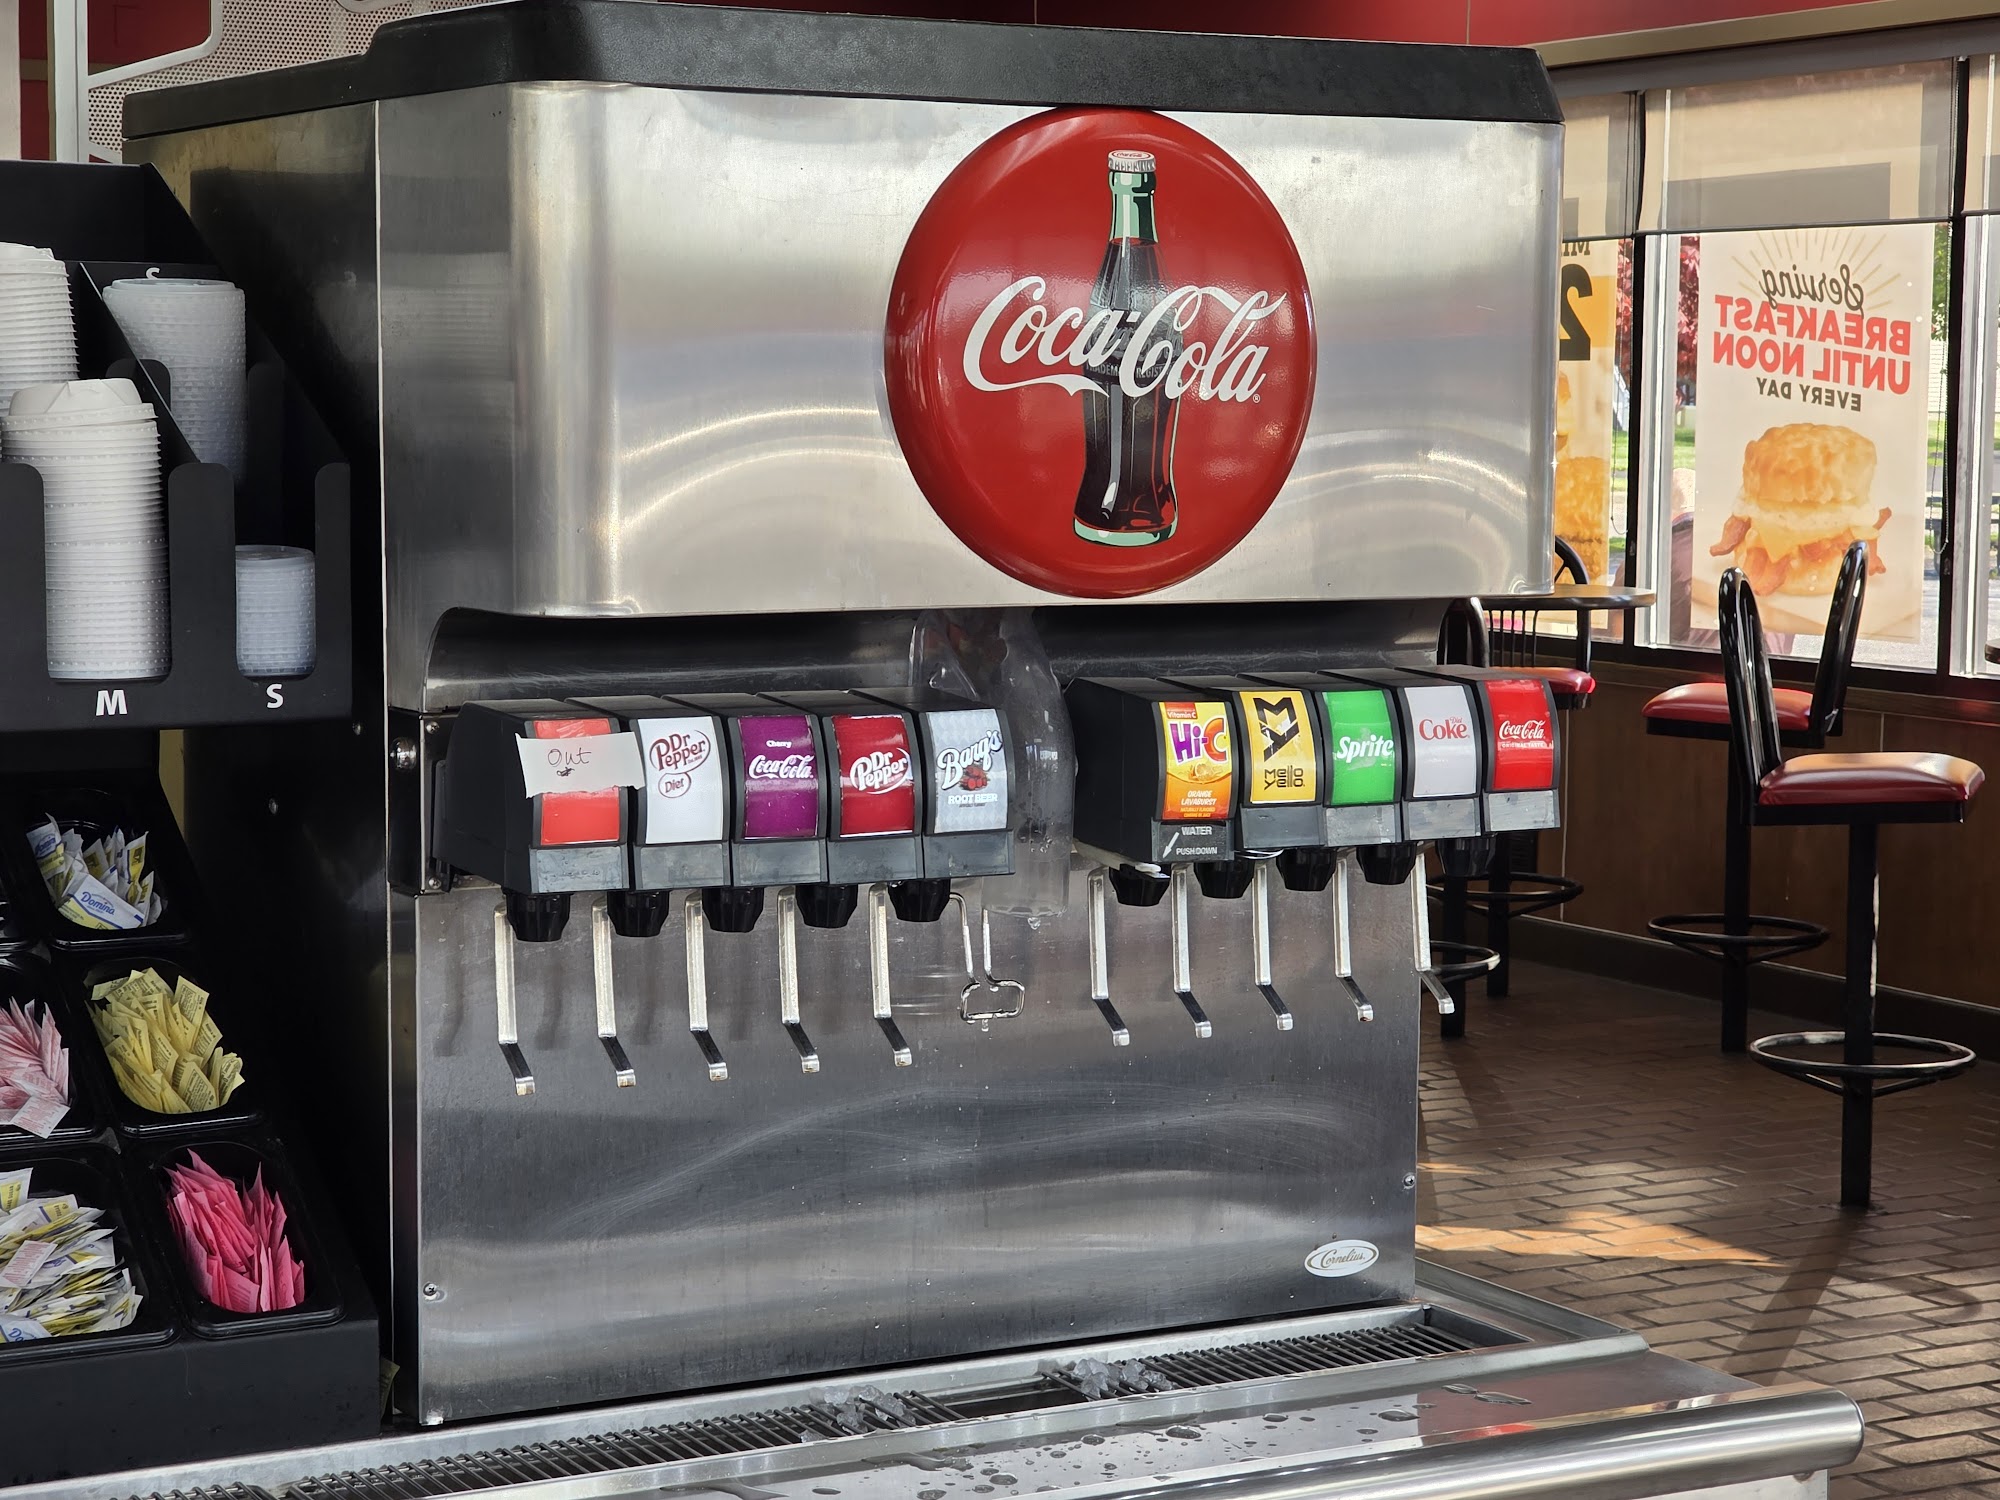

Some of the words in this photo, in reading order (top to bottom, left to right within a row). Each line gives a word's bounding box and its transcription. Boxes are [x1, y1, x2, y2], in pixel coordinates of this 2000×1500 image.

[963, 276, 1287, 403] Coca-Cola
[95, 689, 127, 716] M
[266, 683, 284, 709] S
[1169, 716, 1228, 764] Hi-C
[1418, 718, 1468, 741] Coke
[1499, 719, 1546, 740] Coca-Cola
[667, 733, 691, 749] Dr
[1336, 733, 1394, 764] Sprite
[547, 746, 592, 767] Out
[652, 738, 706, 772] Pepper
[869, 751, 894, 770] Dr
[936, 729, 1004, 791] Barq's
[851, 756, 908, 791] Pepper
[1264, 765, 1304, 780] Mello
[1264, 775, 1305, 791] Yello
[664, 779, 685, 794] Diet
[1187, 790, 1213, 798] ORANGE
[947, 794, 974, 804] ROOT
[974, 792, 998, 803] BEER
[1181, 826, 1213, 835] WATER
[1176, 847, 1195, 855] PUSH
[1195, 846, 1218, 855] DOWN
[80, 891, 116, 915] Domino
[1320, 1248, 1365, 1268] Cornelius
